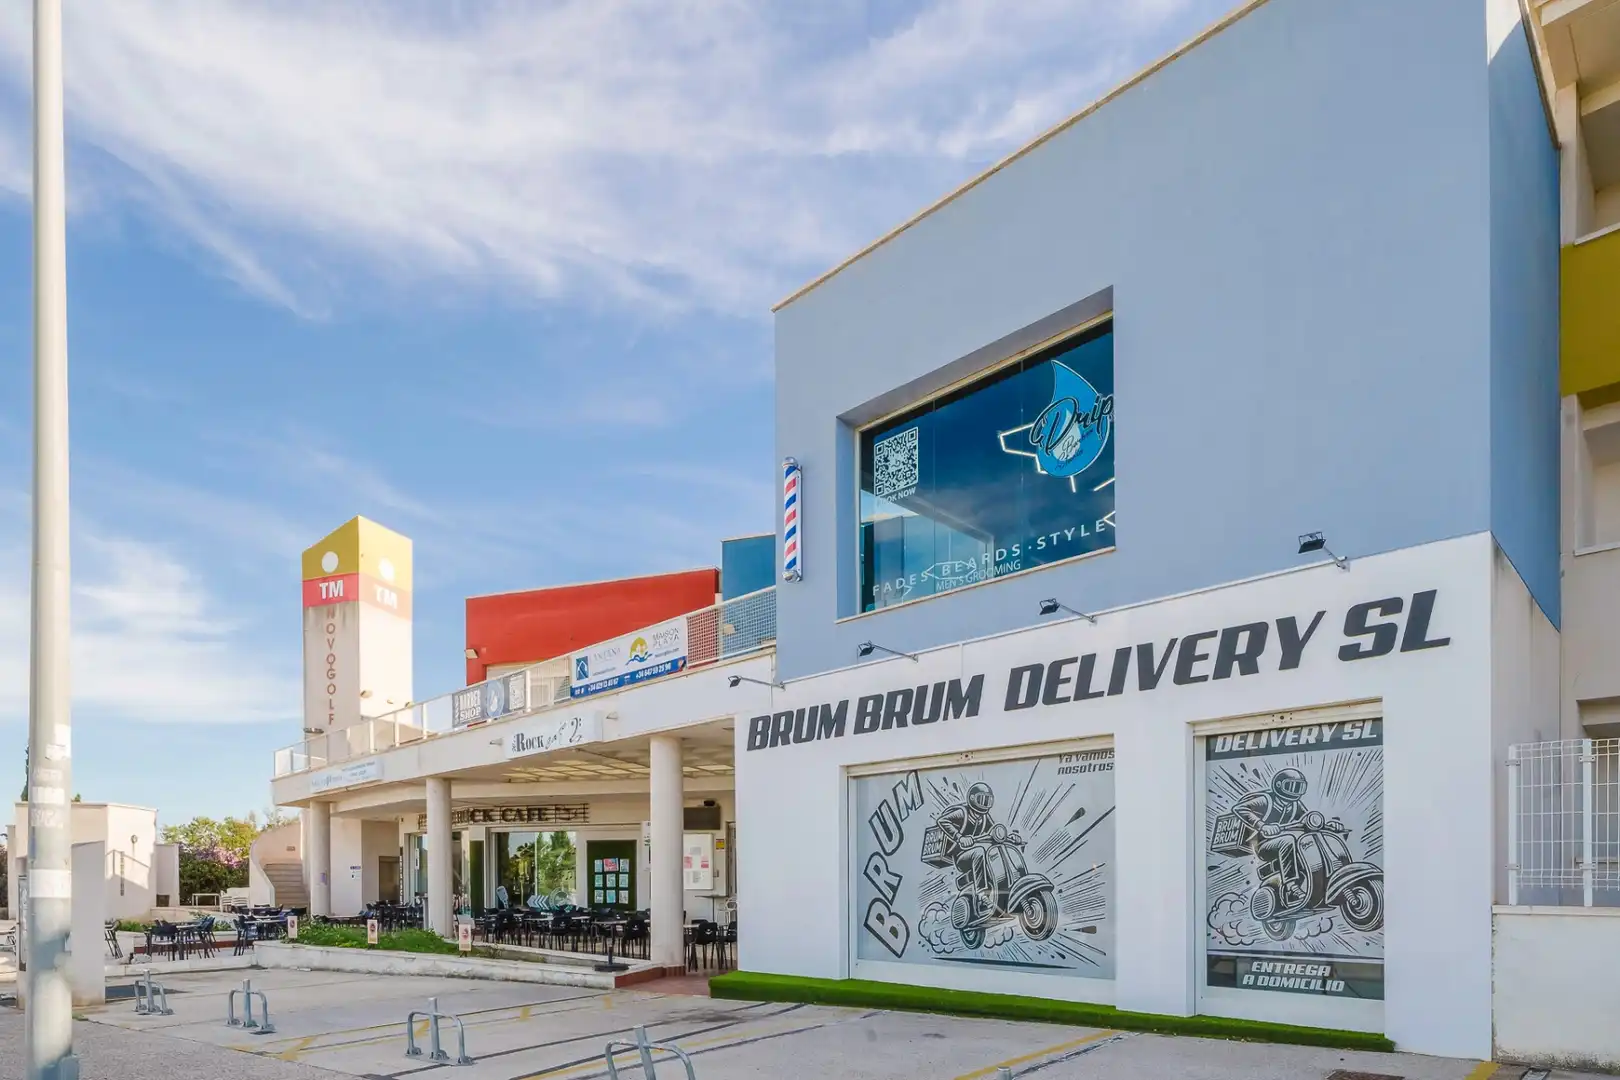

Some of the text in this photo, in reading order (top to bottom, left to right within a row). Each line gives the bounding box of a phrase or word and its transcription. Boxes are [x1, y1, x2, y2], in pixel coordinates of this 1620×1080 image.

[1029, 394, 1114, 456] Drip
[898, 486, 917, 499] NOW
[872, 518, 1106, 596] FADES BEARDS STYLE
[965, 559, 1021, 584] GROOMING
[319, 580, 344, 600] TM
[374, 583, 398, 610] TM
[326, 607, 337, 726] NOVOGOLF
[747, 589, 1452, 751] BRUM BRUM DELIVERY SL
[460, 706, 481, 720] SHOP
[1214, 719, 1377, 753] DELIVERY SL
[1076, 750, 1115, 762] vamos
[1057, 762, 1114, 775] nosotros
[1216, 818, 1241, 833] BRUM
[1213, 829, 1239, 844] BRUM
[863, 770, 924, 958] BRUM
[1251, 961, 1331, 977] ENTREGA
[1242, 974, 1345, 992] A DOMICILIO
